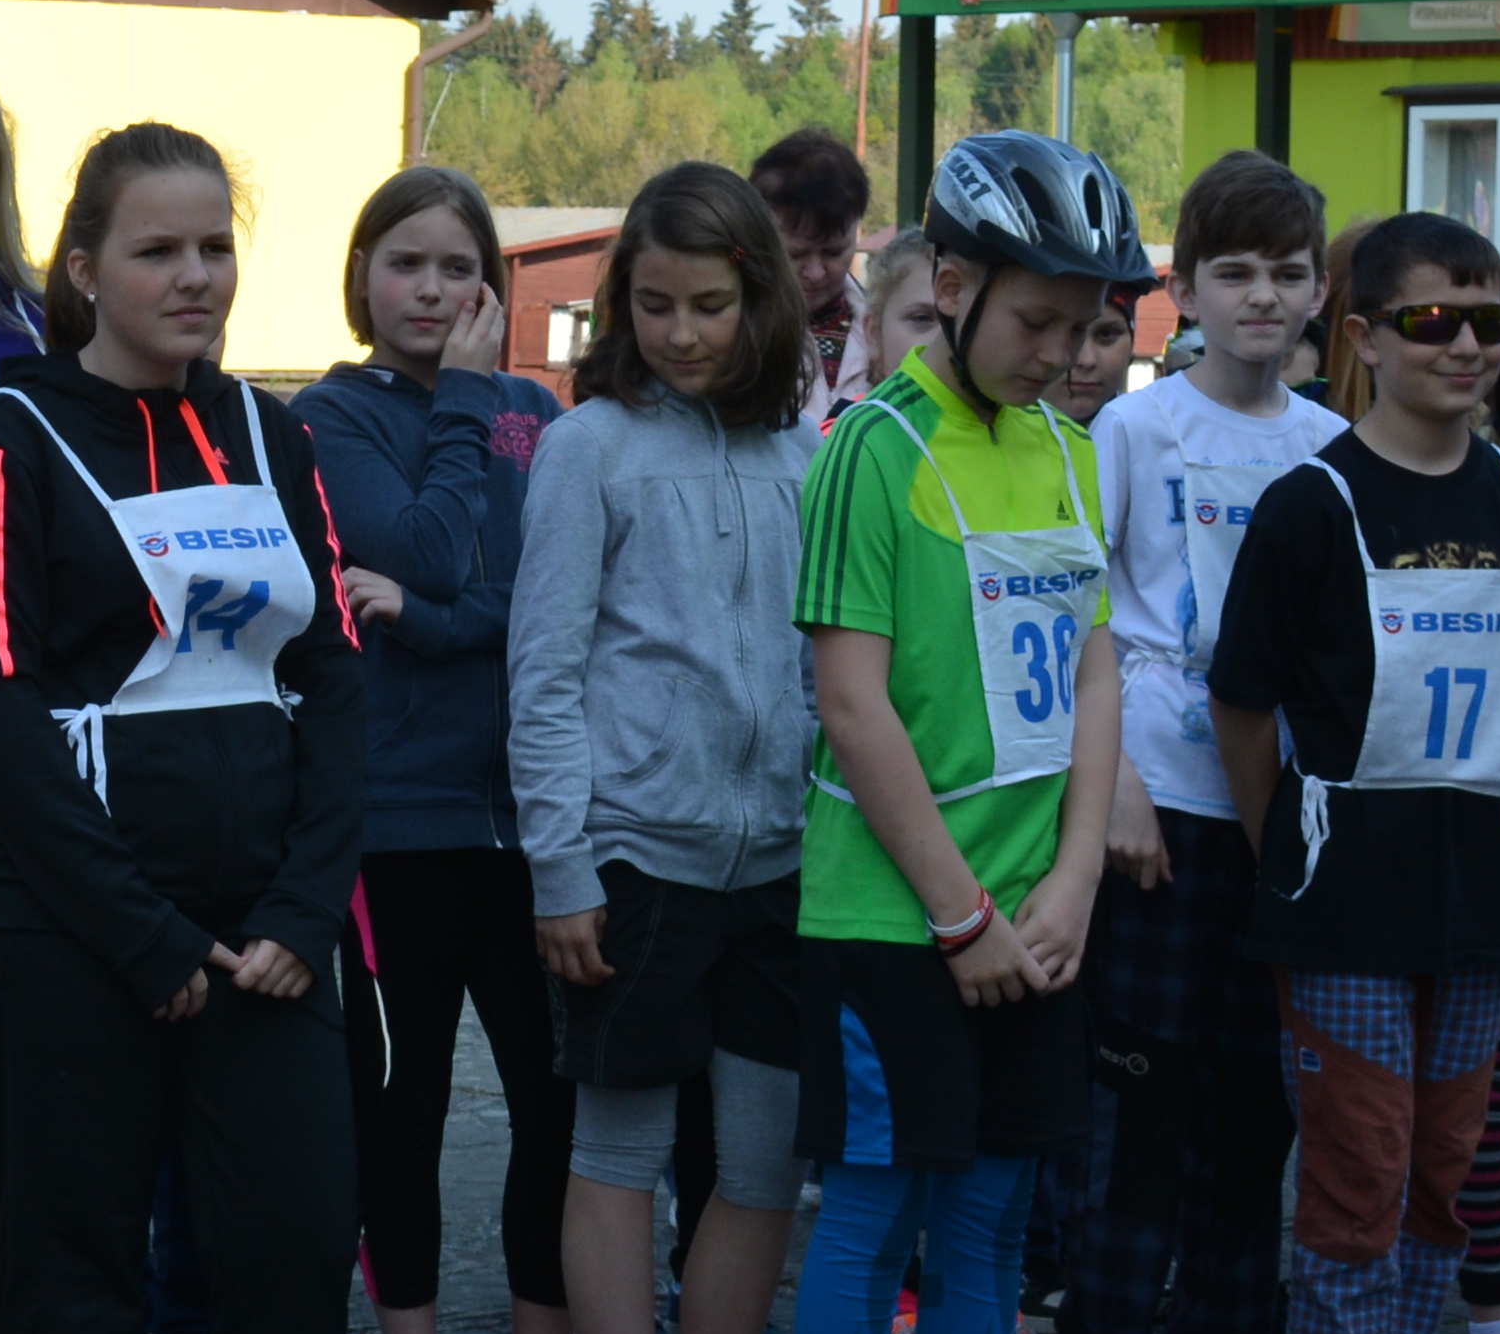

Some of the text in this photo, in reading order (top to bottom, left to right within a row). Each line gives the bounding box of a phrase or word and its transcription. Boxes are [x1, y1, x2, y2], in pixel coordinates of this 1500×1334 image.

[174, 527, 288, 550] BESIP
[1006, 569, 1099, 596] BESIP
[1424, 666, 1487, 760] 17
